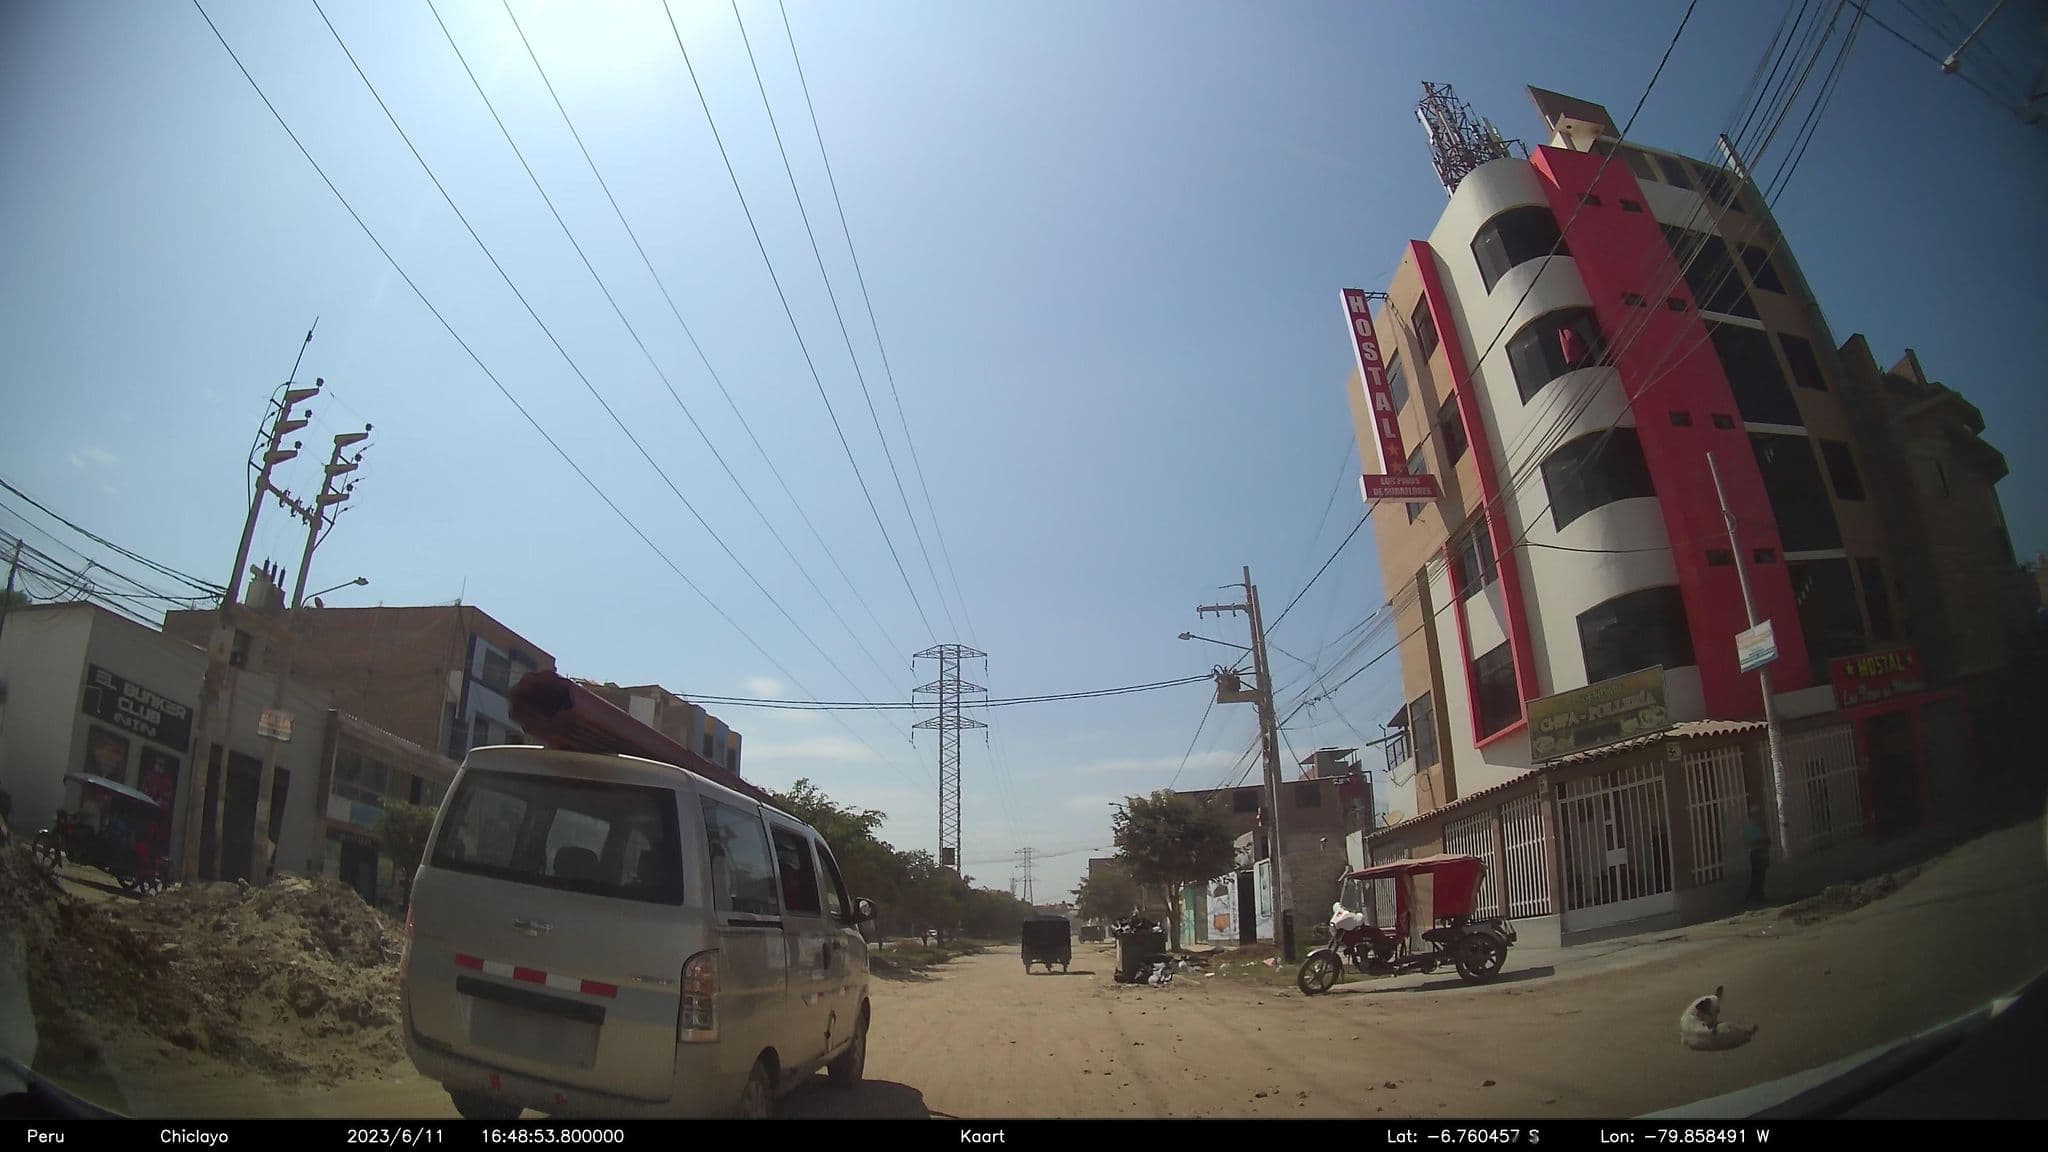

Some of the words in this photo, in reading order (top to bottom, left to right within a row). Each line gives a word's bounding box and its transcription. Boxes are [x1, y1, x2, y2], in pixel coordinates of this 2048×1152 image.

[1348, 295, 1397, 439] HOSTAL
[95, 669, 117, 691] EL
[123, 681, 187, 720] BUNKER
[117, 696, 161, 725] CLUB
